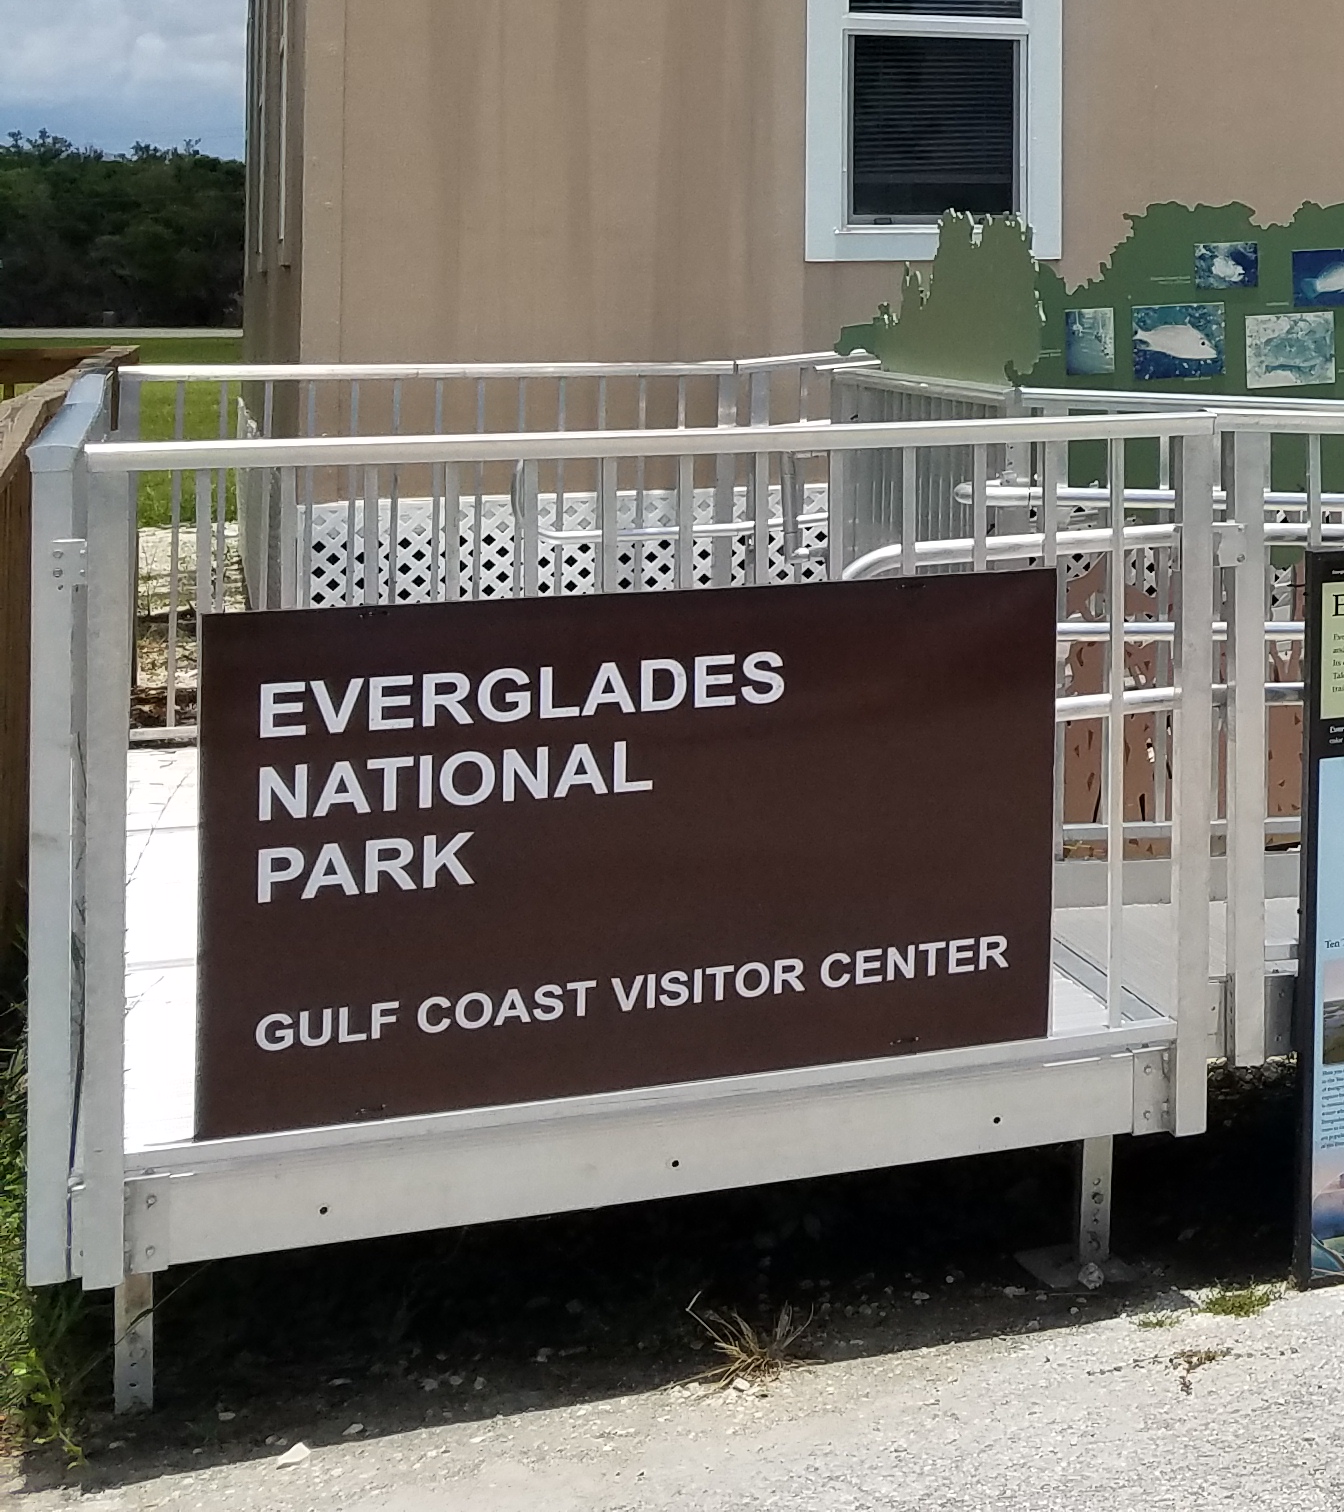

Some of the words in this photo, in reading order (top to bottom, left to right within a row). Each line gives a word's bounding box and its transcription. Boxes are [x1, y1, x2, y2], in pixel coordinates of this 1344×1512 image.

[259, 650, 786, 739] EVERGLADES
[258, 740, 654, 822] NATIONAL
[256, 831, 475, 904] PARK
[1325, 939, 1340, 949] Ten
[255, 1001, 398, 1052] GULF
[415, 980, 597, 1036] COAST
[611, 957, 805, 1013] VISITOR
[819, 935, 1010, 990] CENTER
